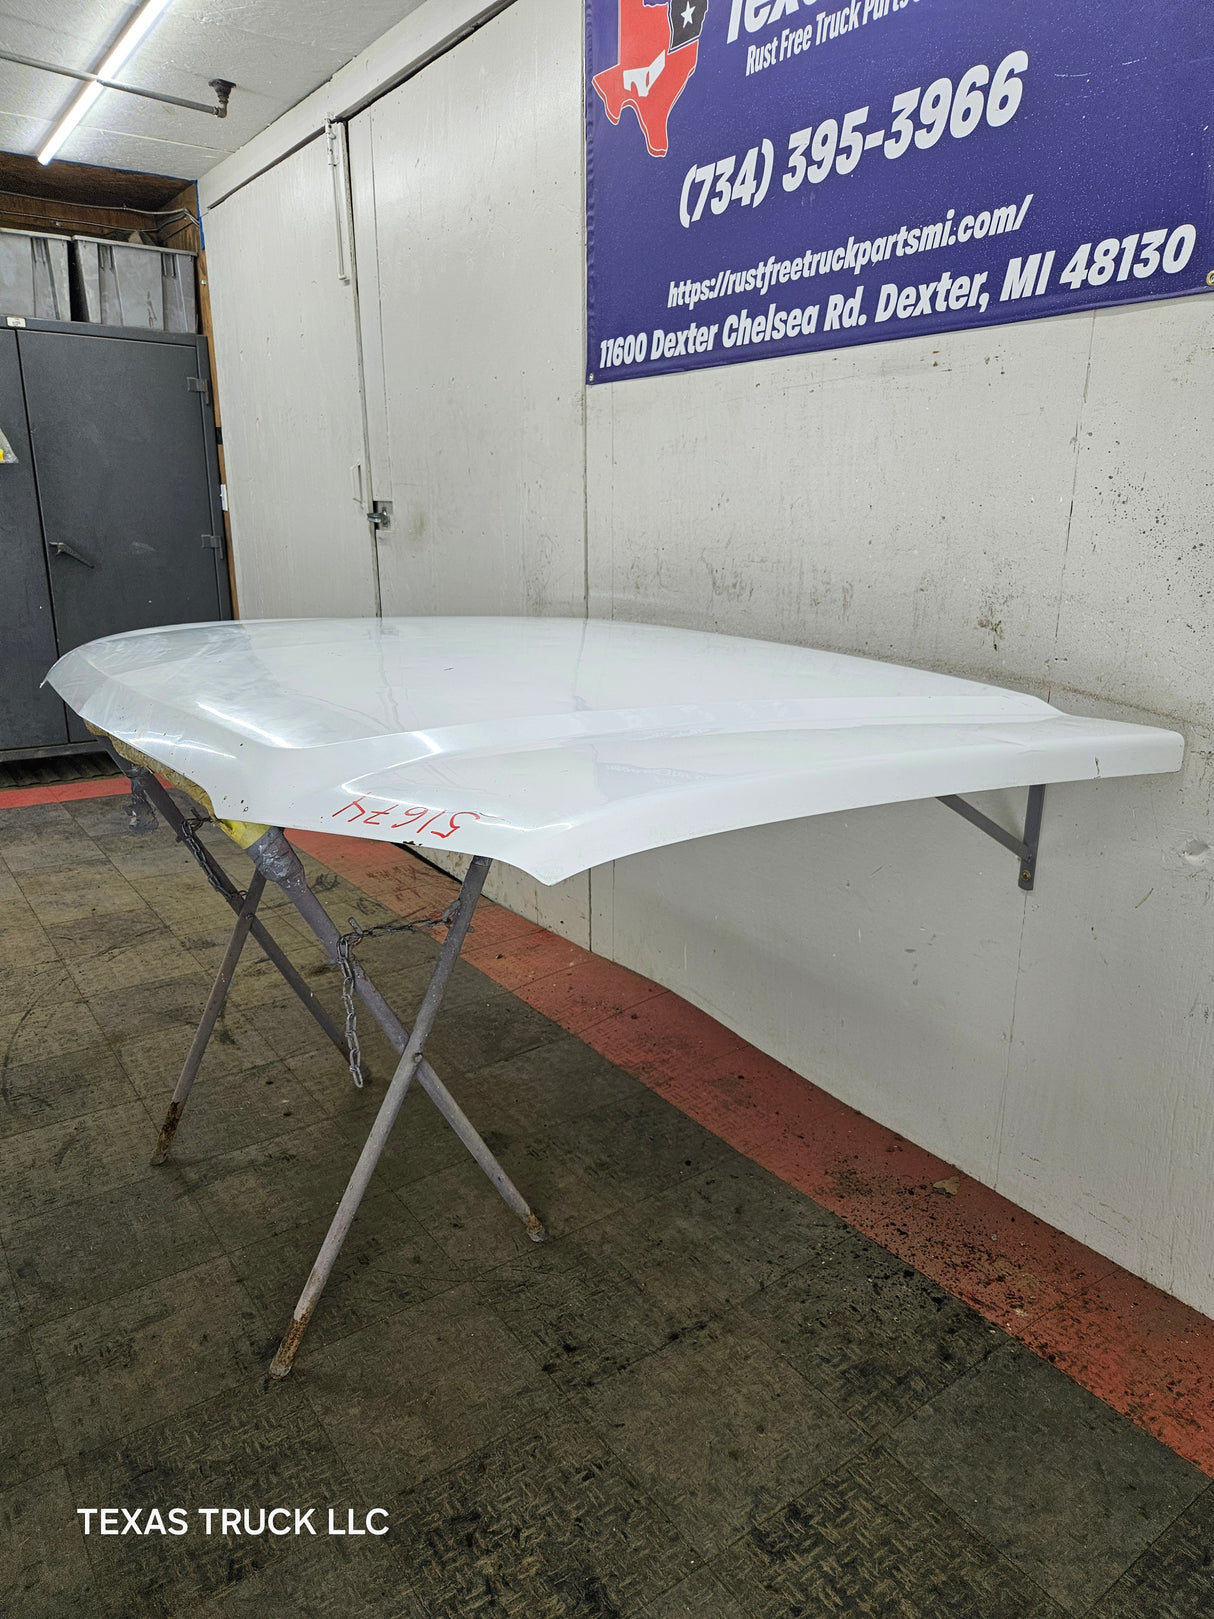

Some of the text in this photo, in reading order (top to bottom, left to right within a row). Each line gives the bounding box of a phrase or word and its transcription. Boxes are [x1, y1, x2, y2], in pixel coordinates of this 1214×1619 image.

[727, 0, 818, 44] Tex
[745, 37, 778, 77] Rust
[779, 25, 812, 61] Free
[815, 0, 862, 46] Truck
[679, 50, 1029, 229] (734) 395-3966
[599, 224, 1197, 369] 11600 Dexter Chelsea Rd. Dexter, MI 48130
[667, 194, 1034, 311] https://rustfreetruckpartsmi.com/
[331, 791, 481, 839] 51674
